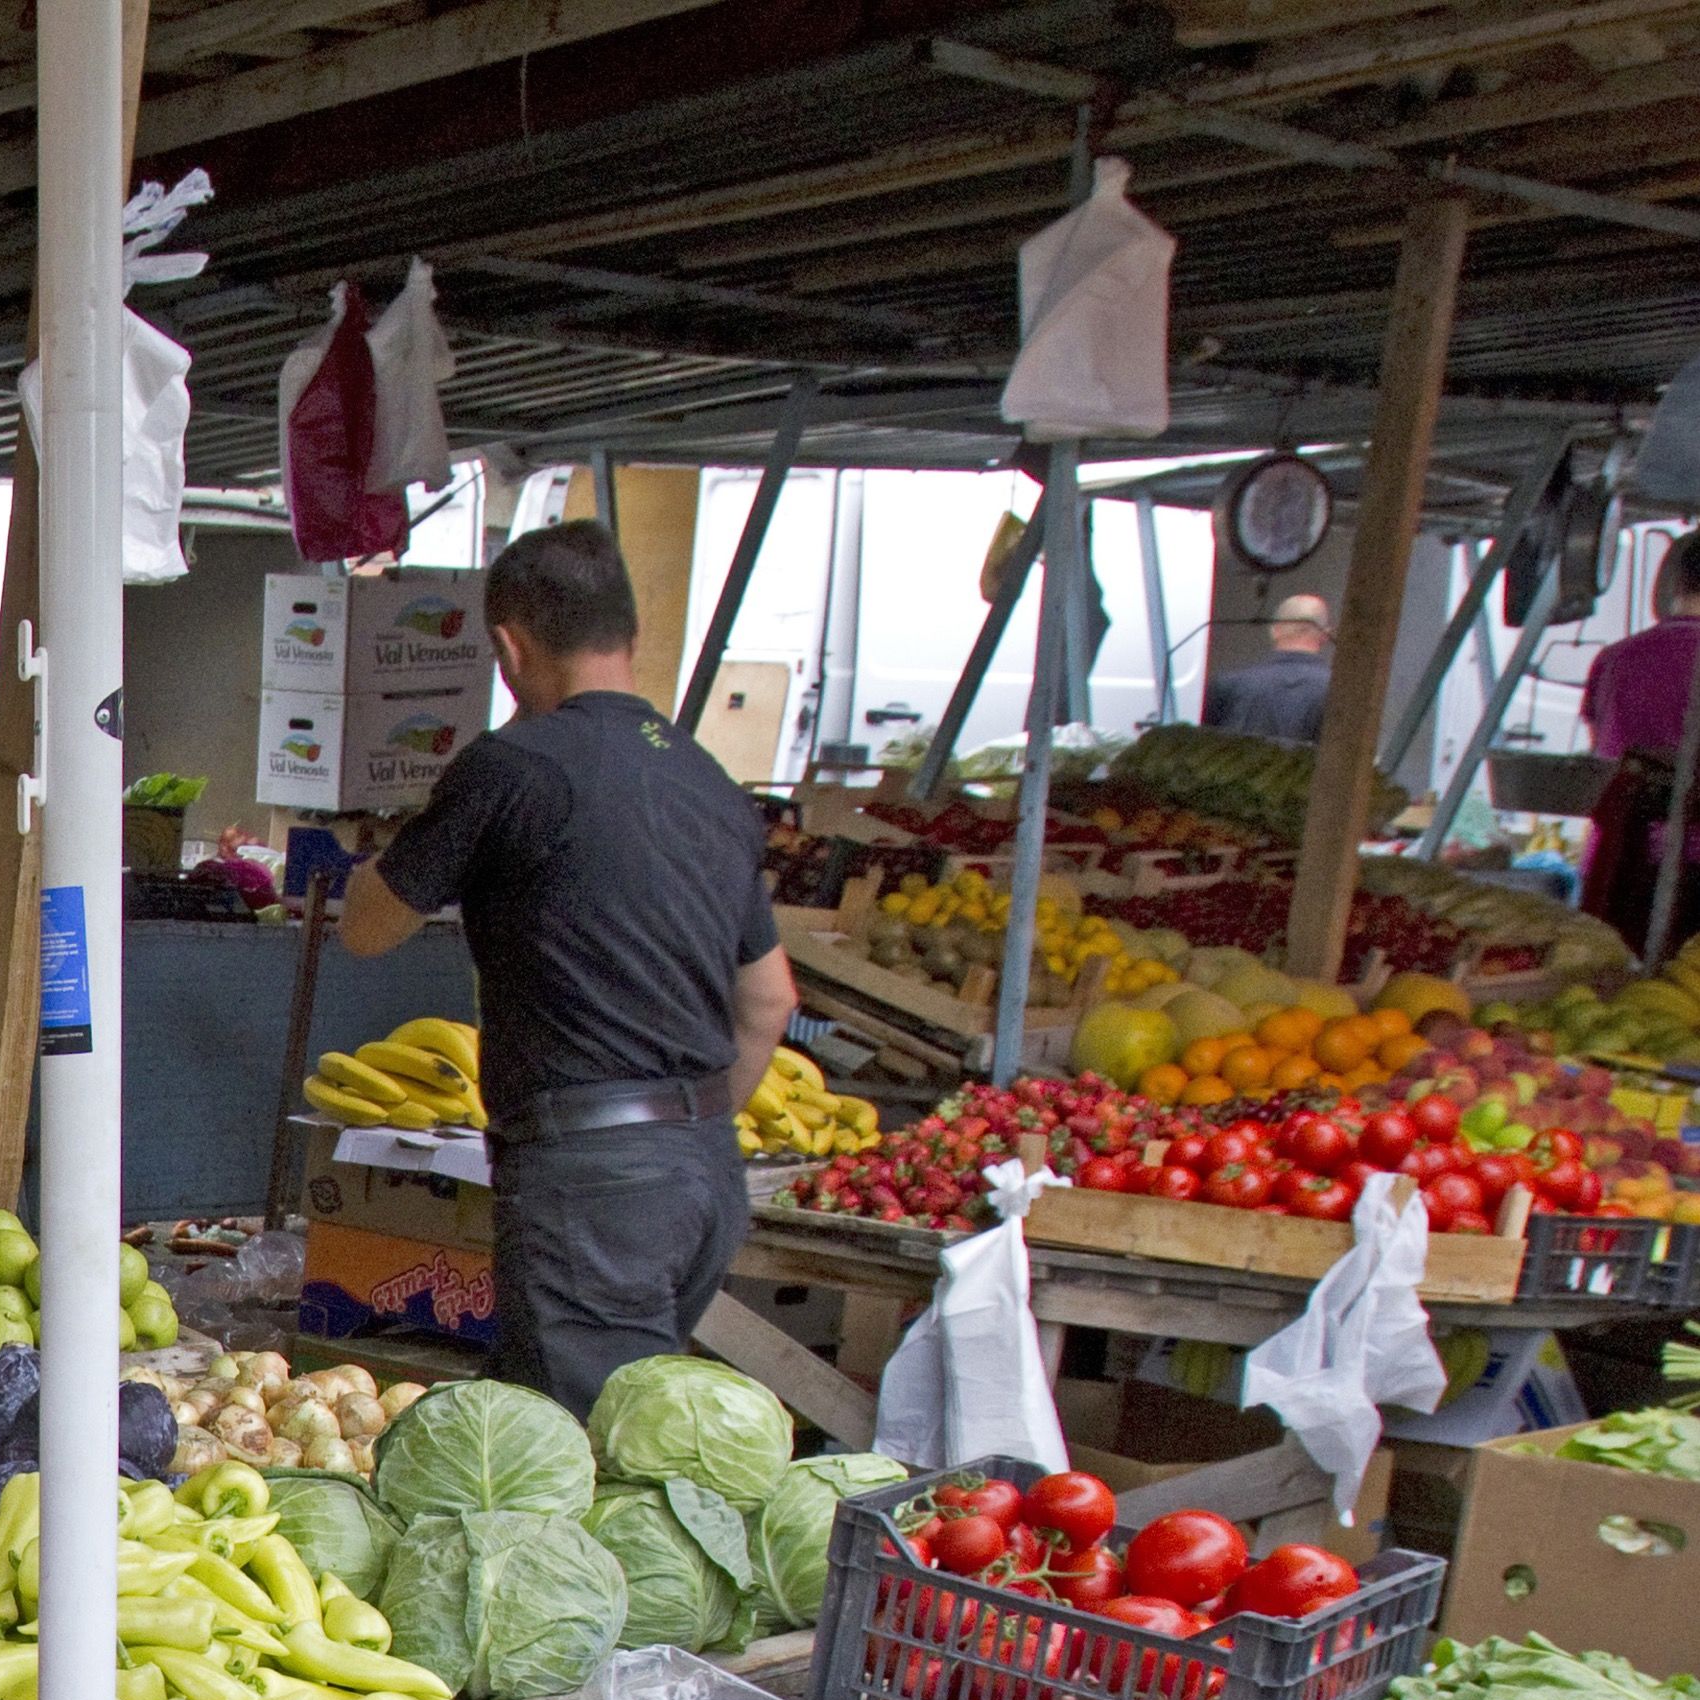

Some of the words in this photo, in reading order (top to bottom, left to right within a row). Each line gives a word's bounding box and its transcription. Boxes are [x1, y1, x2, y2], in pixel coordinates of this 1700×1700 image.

[374, 644, 403, 665] Val
[406, 642, 479, 663] Venosta
[367, 761, 397, 783] Val
